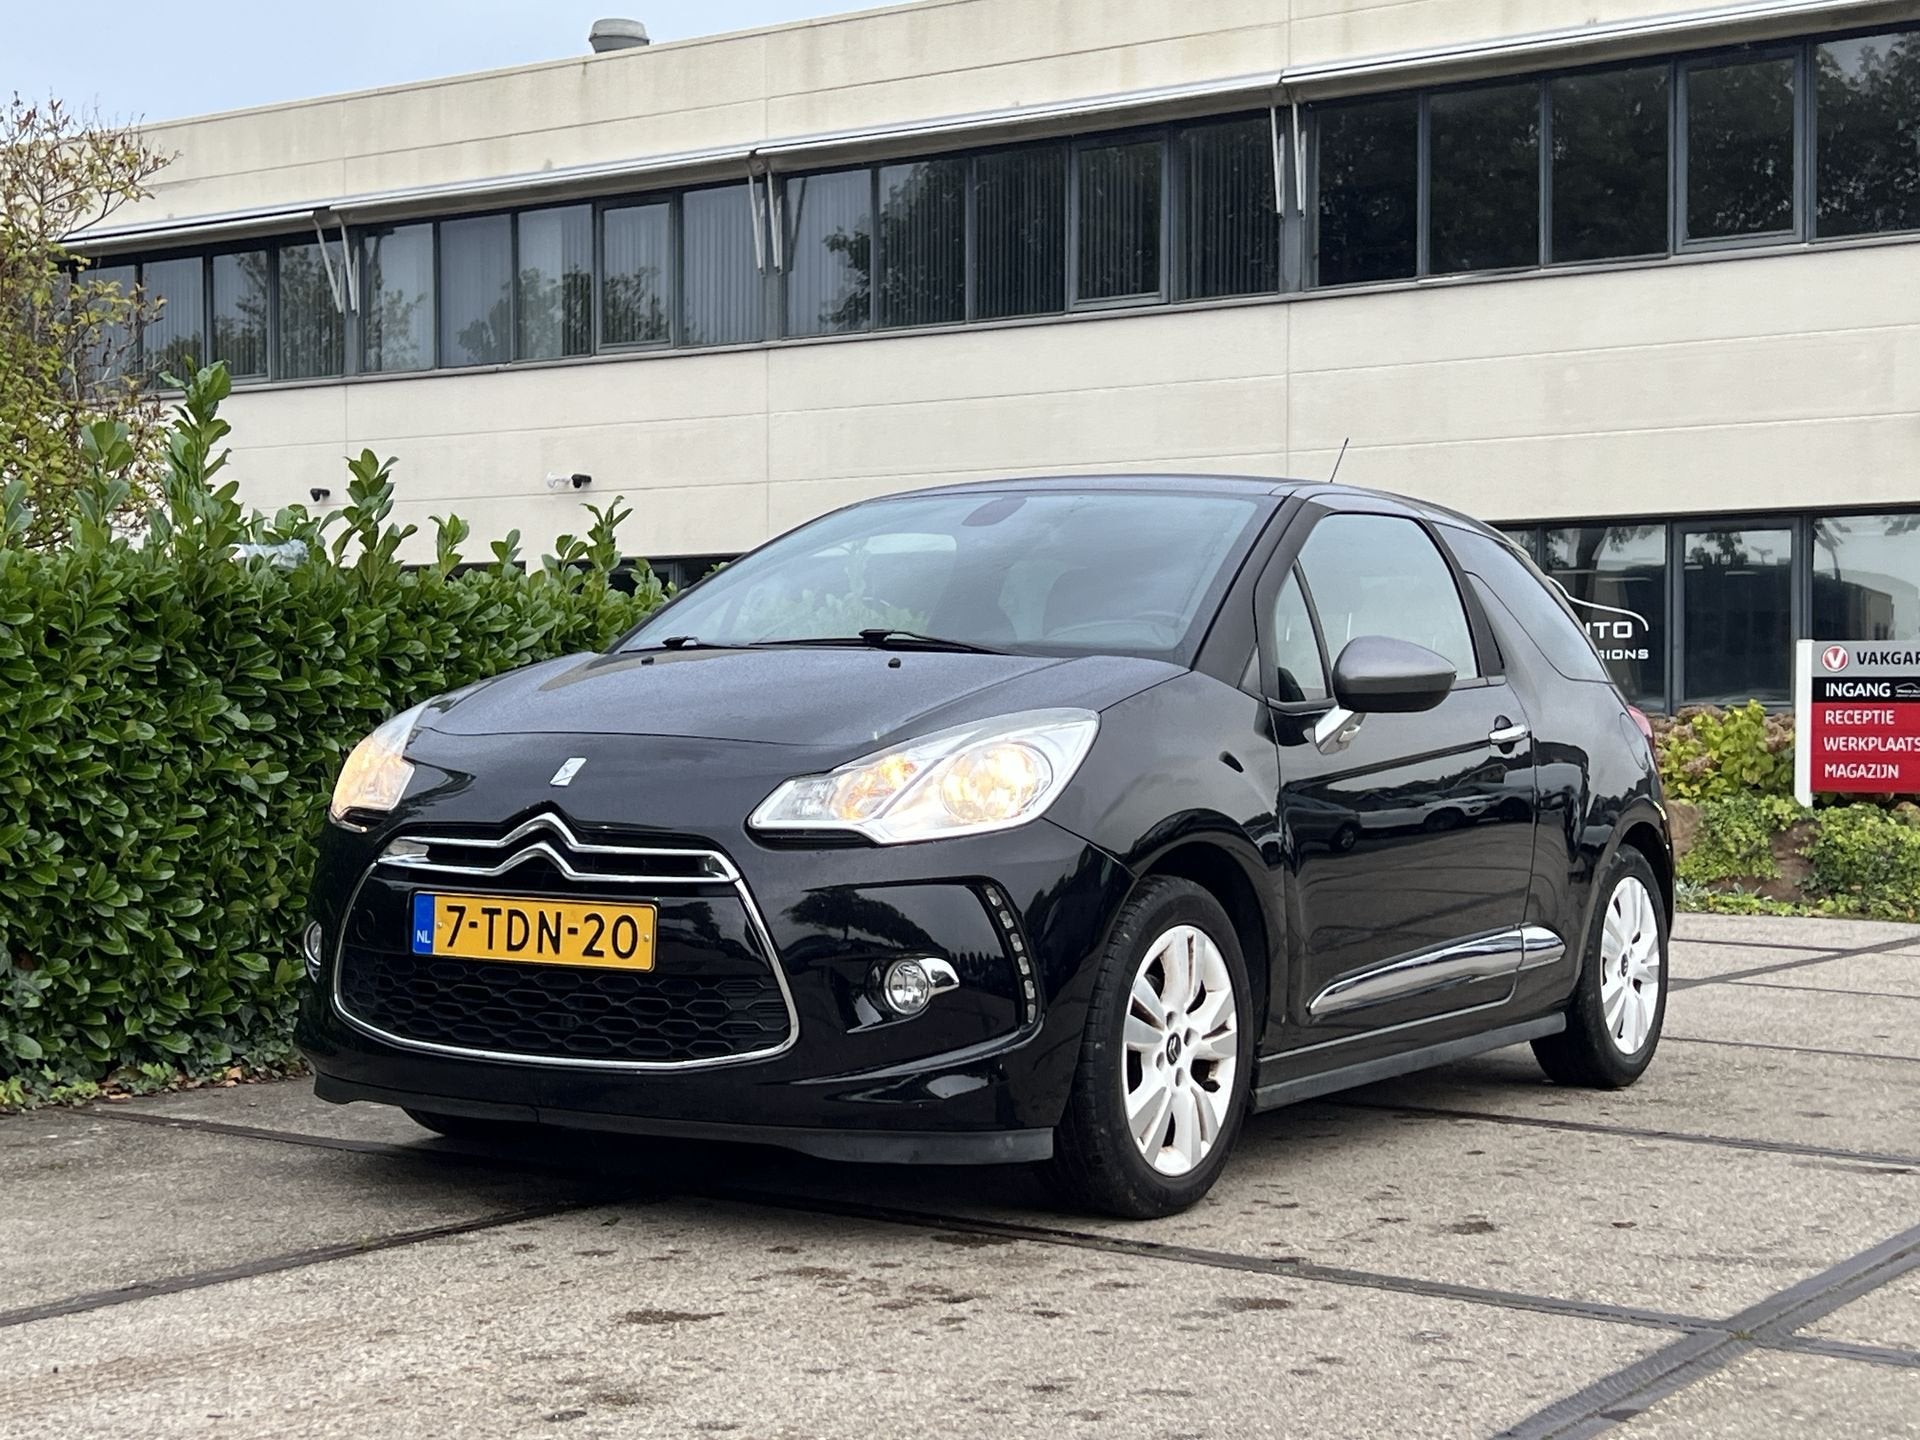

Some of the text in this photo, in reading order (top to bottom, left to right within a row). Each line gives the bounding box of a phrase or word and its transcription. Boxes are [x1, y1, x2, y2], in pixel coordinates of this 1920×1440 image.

[1825, 682, 1891, 697] INGANG
[1825, 709, 1895, 725] RECEPTIE
[1823, 736, 1920, 752] WERKPLAATS
[1824, 763, 1899, 779] MAGAZIJN
[416, 929, 431, 944] NL
[446, 905, 638, 959] 7-TDN-20
